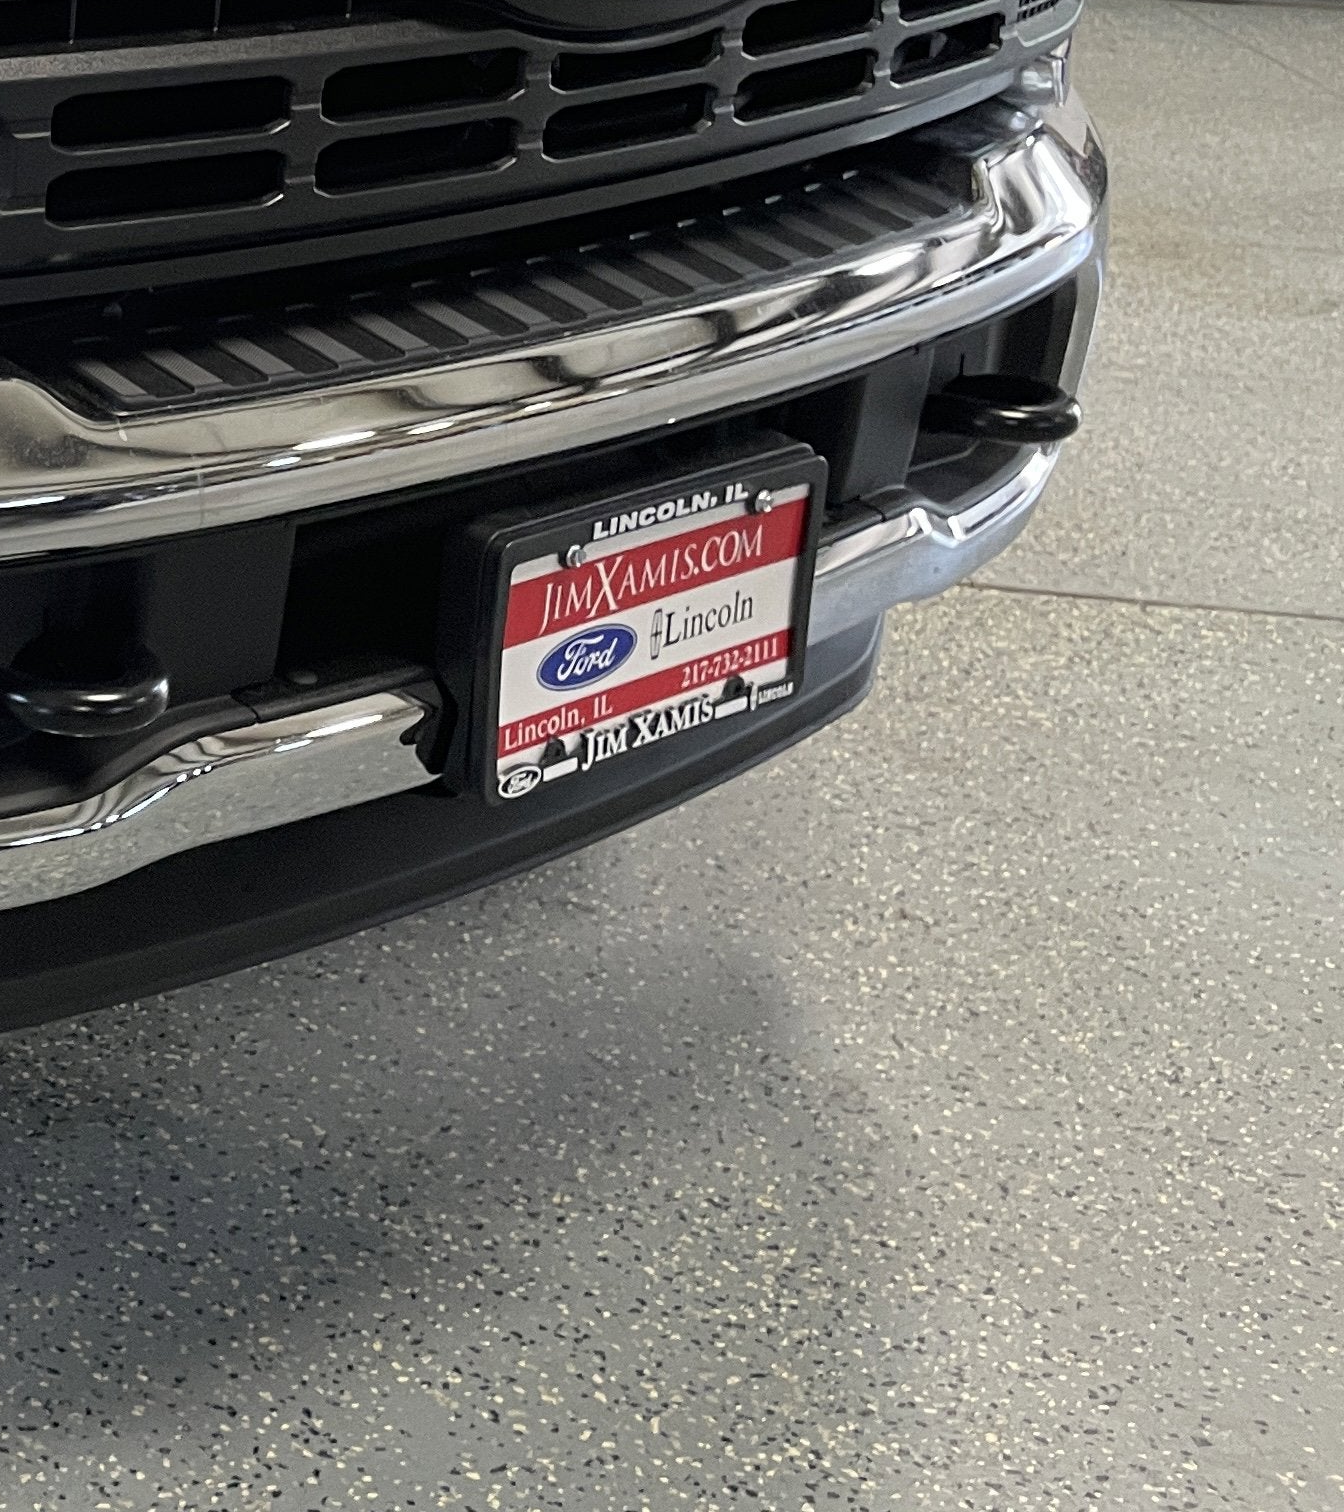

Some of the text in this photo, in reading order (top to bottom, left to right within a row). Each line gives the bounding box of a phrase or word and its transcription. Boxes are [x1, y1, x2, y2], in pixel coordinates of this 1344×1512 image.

[592, 482, 749, 540] LINCOLN, IL
[662, 590, 754, 649] Lincoln
[556, 633, 619, 683] Ford
[680, 637, 779, 688] 217-732-2111
[504, 695, 614, 751] Lincoln, IL
[581, 698, 714, 772] JIM XAMIS
